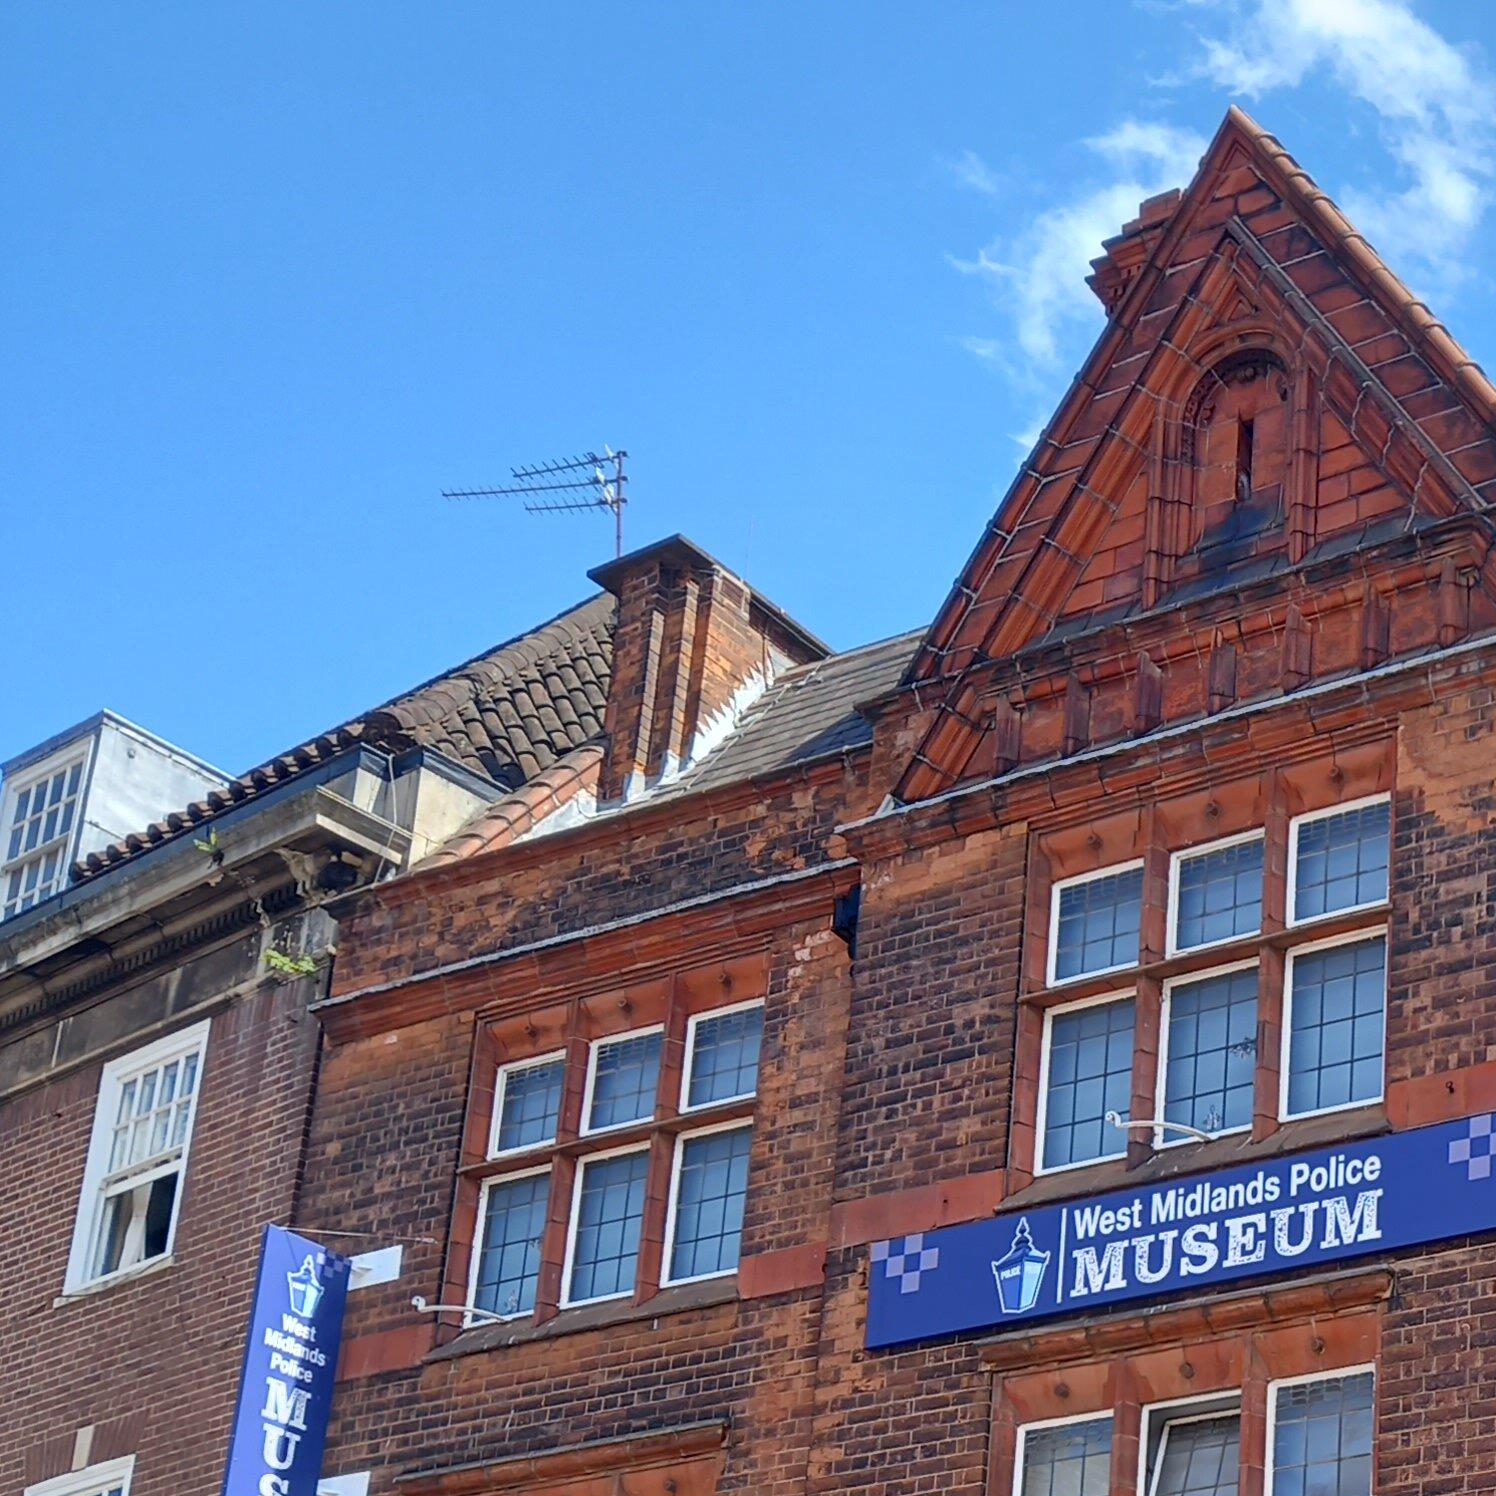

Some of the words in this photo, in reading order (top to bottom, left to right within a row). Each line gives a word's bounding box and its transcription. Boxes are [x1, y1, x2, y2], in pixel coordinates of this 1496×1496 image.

[1074, 1198, 1143, 1240] West
[1151, 1171, 1281, 1225] Midlands
[1290, 1154, 1382, 1197] Police
[1070, 1188, 1383, 1298] MUSEUM
[263, 1327, 326, 1367] Midlands
[282, 1313, 317, 1342] West
[269, 1351, 314, 1383] Police
